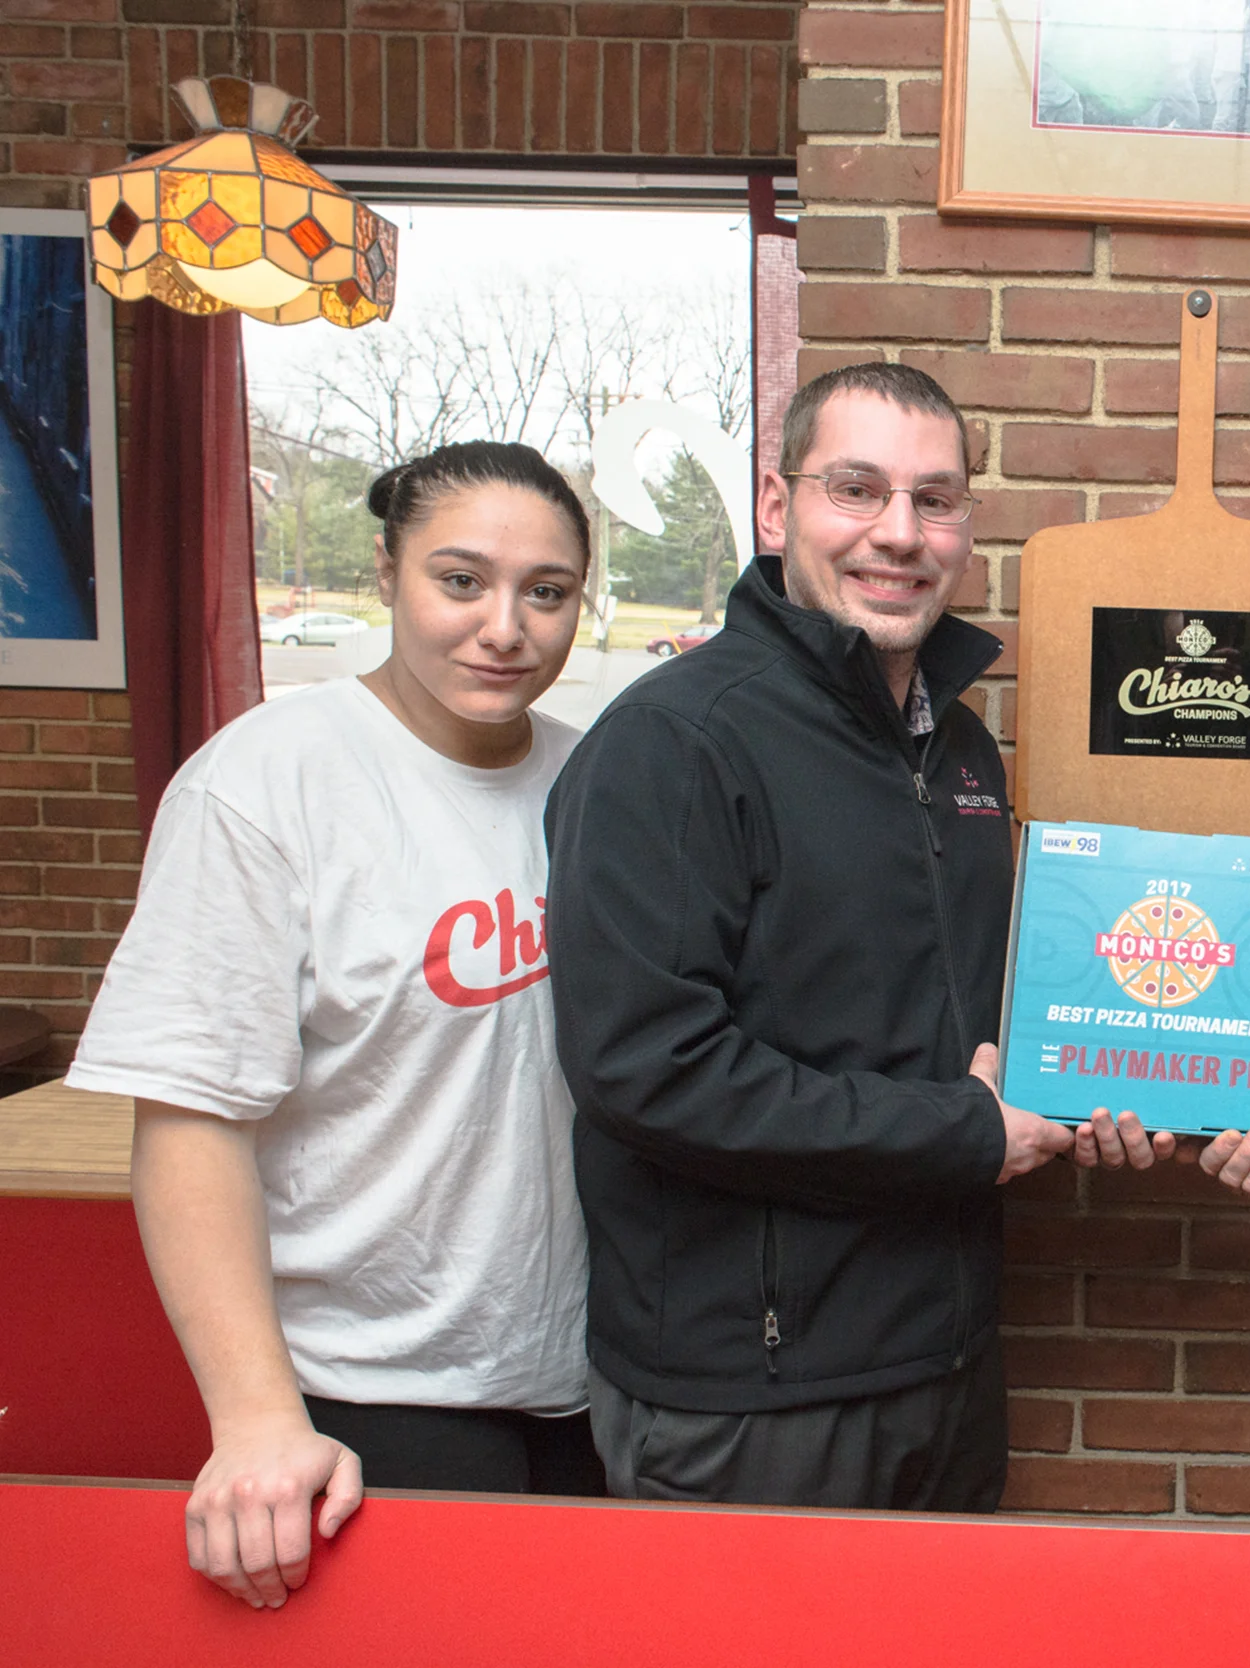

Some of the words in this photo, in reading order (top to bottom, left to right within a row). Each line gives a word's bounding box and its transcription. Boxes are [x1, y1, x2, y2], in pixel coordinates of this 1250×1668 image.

[1174, 708, 1238, 721] CHAMPIONS
[1183, 734, 1216, 744] VALLEY
[1218, 736, 1247, 745] FORGE
[1043, 838, 1071, 847] IBEW
[1077, 837, 1098, 852] 98
[1145, 879, 1192, 898] 2017
[1100, 934, 1232, 964] MONTCO'S
[1047, 1005, 1094, 1025] BEST
[1095, 1008, 1147, 1028] PIZZA
[1040, 1044, 1060, 1073] THE
[1058, 1045, 1221, 1086] PLAYMAKER
